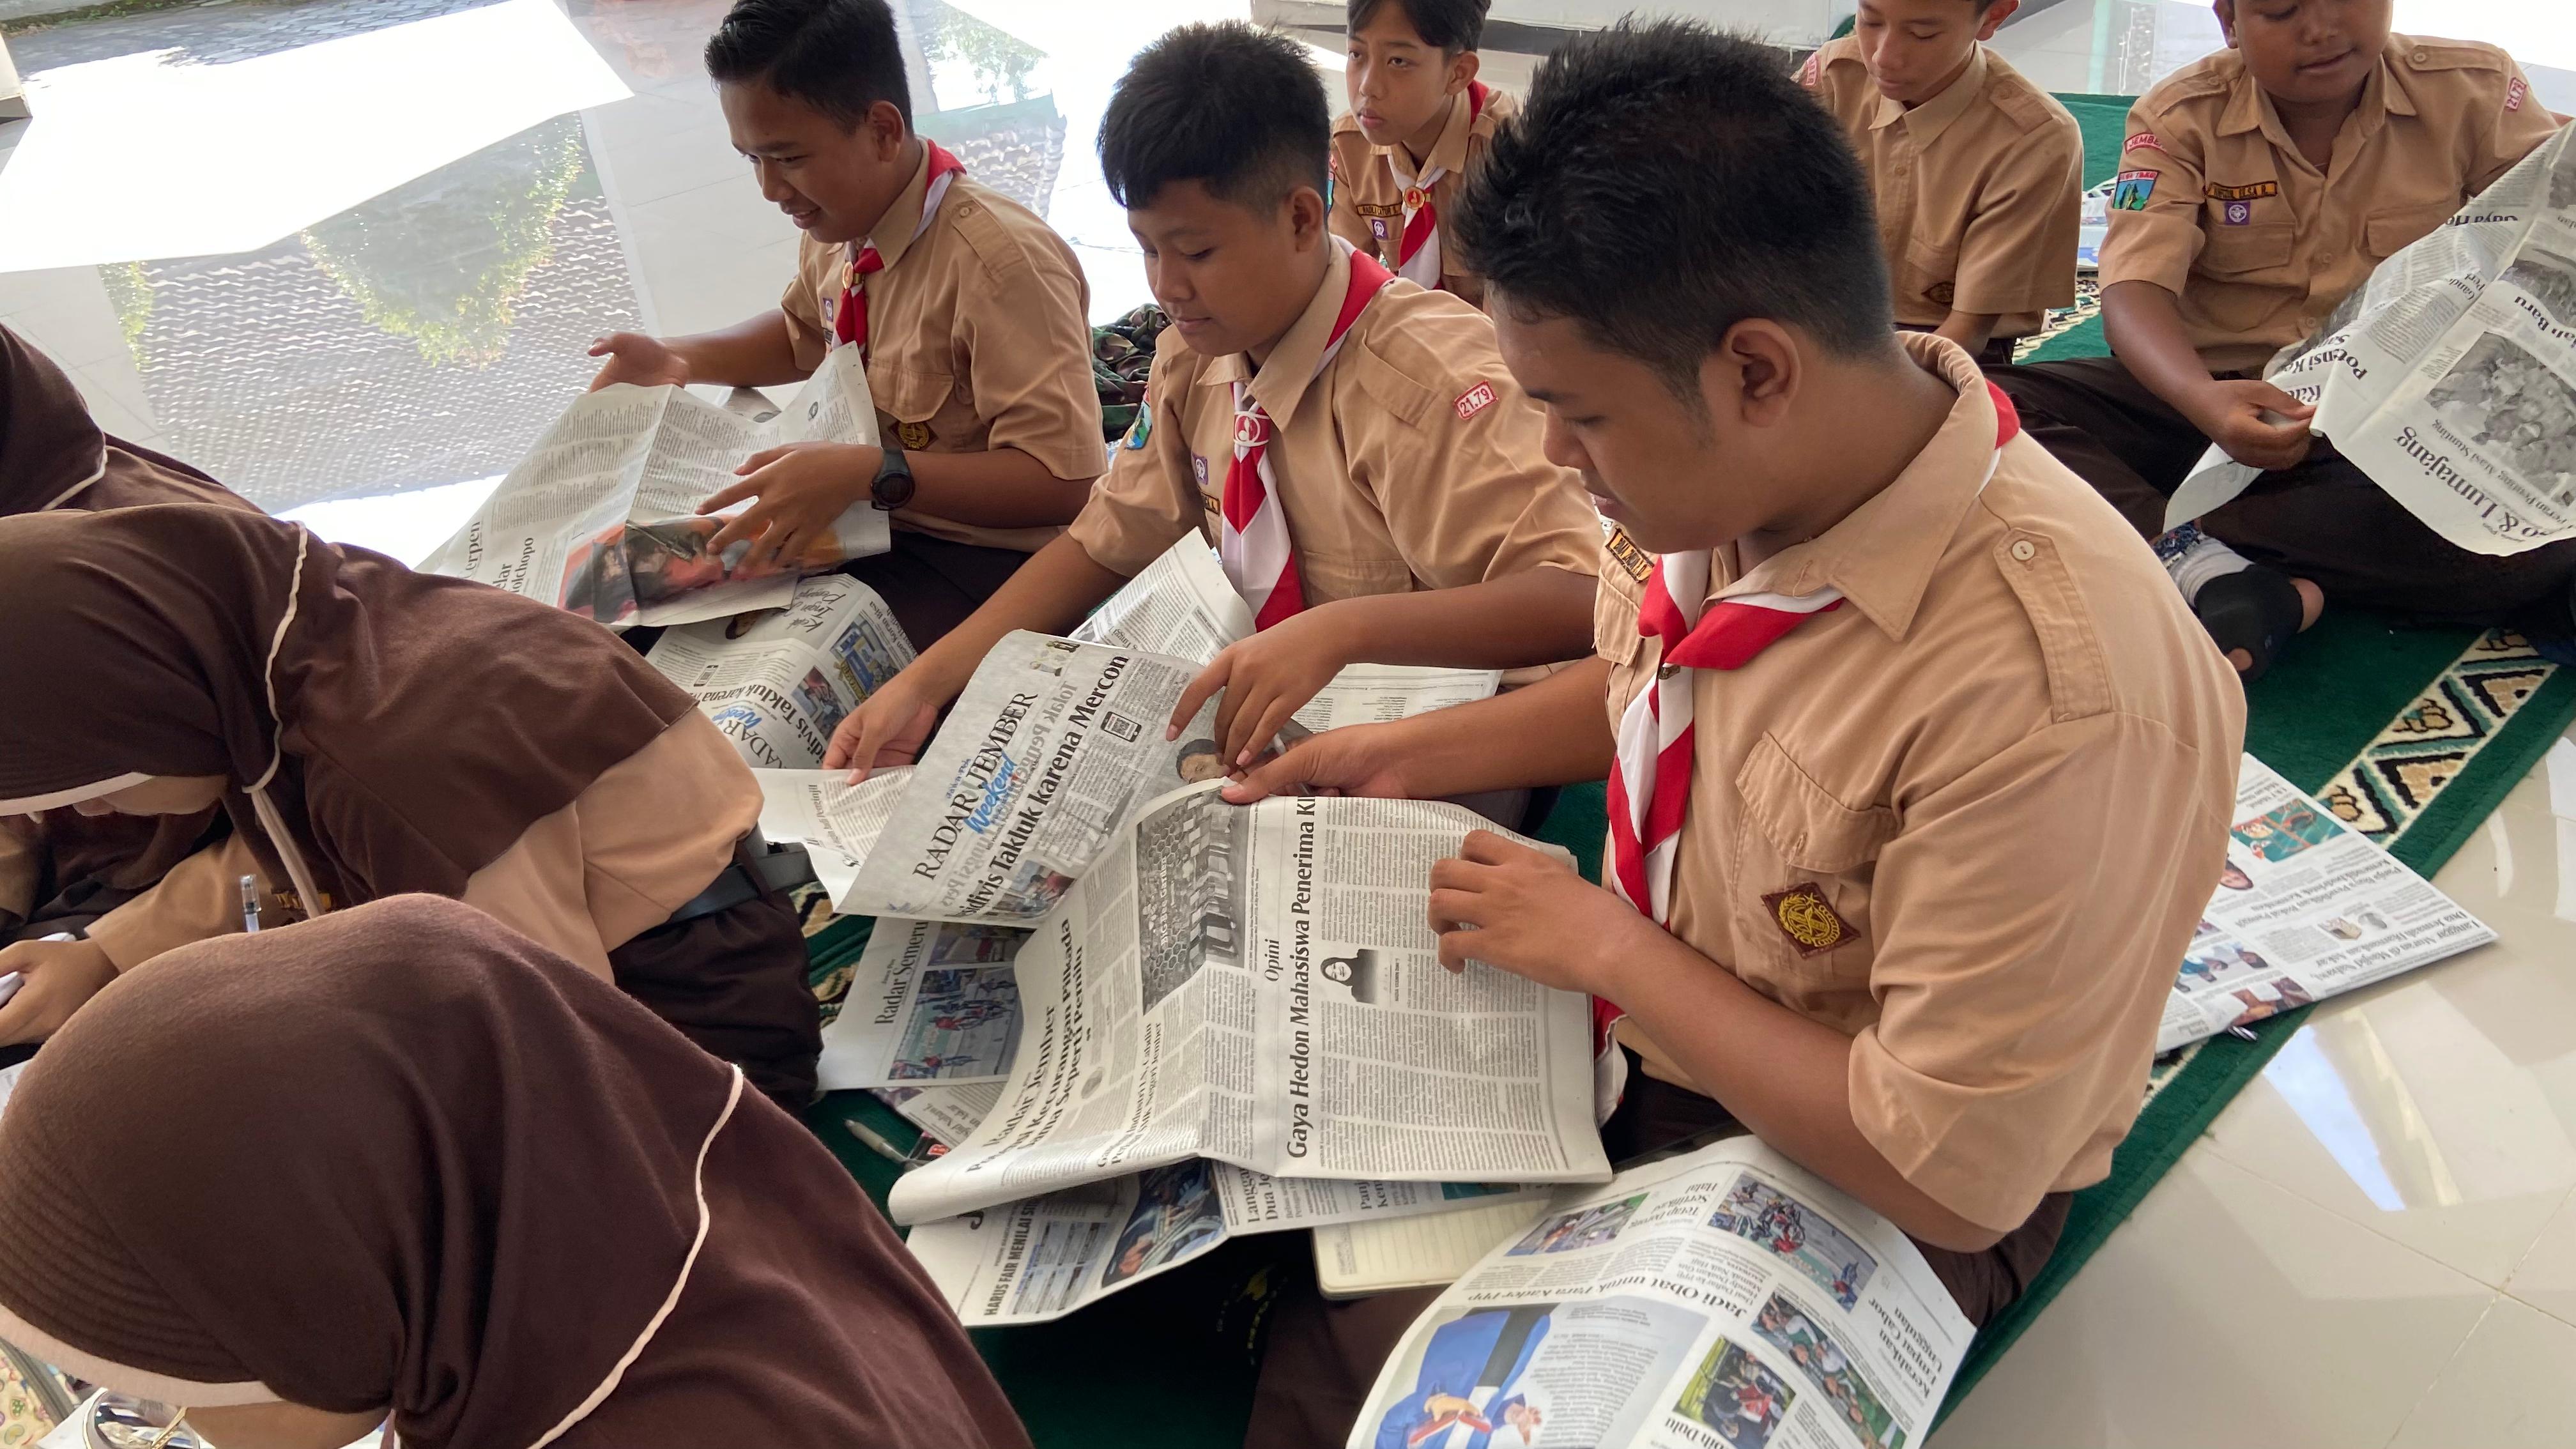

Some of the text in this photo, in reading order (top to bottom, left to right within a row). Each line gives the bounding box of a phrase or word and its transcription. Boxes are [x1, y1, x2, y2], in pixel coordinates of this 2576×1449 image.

[2129, 134, 2163, 147] JEMBE
[2514, 296, 2550, 332] Baru
[1460, 387, 1491, 415] 21.79
[2393, 426, 2499, 518] Lumajang
[2499, 511, 2519, 532] &
[493, 563, 512, 589] elar
[511, 537, 535, 593] olchopo
[745, 684, 797, 725] Takluk
[723, 719, 785, 769] ADAR
[796, 717, 828, 765] idivis
[912, 693, 1039, 880] RADAR JEMBER
[960, 655, 1130, 916] sidivis Takluk karena Mercon
[964, 746, 1018, 834] Weekend
[1296, 795, 1315, 816] KI
[1290, 821, 1315, 915] Penerima
[874, 921, 929, 1025] Radar Semeru
[1264, 938, 1284, 982] Opini
[1289, 919, 1310, 1026] Mahasiswa
[1289, 1029, 1310, 1098] Hedon
[1286, 1103, 1315, 1158] Gaya
[1259, 1172, 1278, 1220] Dua Je
[1354, 1179, 1374, 1209] Panj
[1372, 1179, 1389, 1208] Kem
[1008, 1217, 1032, 1259] MENILAI
[998, 1261, 1019, 1282] FAIR
[1598, 1275, 1646, 1294] untuk
[1651, 1278, 1699, 1300] Obat
[984, 1283, 1010, 1315] HARUS
[1701, 1292, 1747, 1319] Jadi
[1868, 1296, 1901, 1341] Cabor
[1894, 1307, 1943, 1373] Unggulan
[1902, 1338, 1937, 1386] Empat
[1879, 1328, 1930, 1399] Kerahkan
[1664, 1418, 1699, 1442] Dulu
